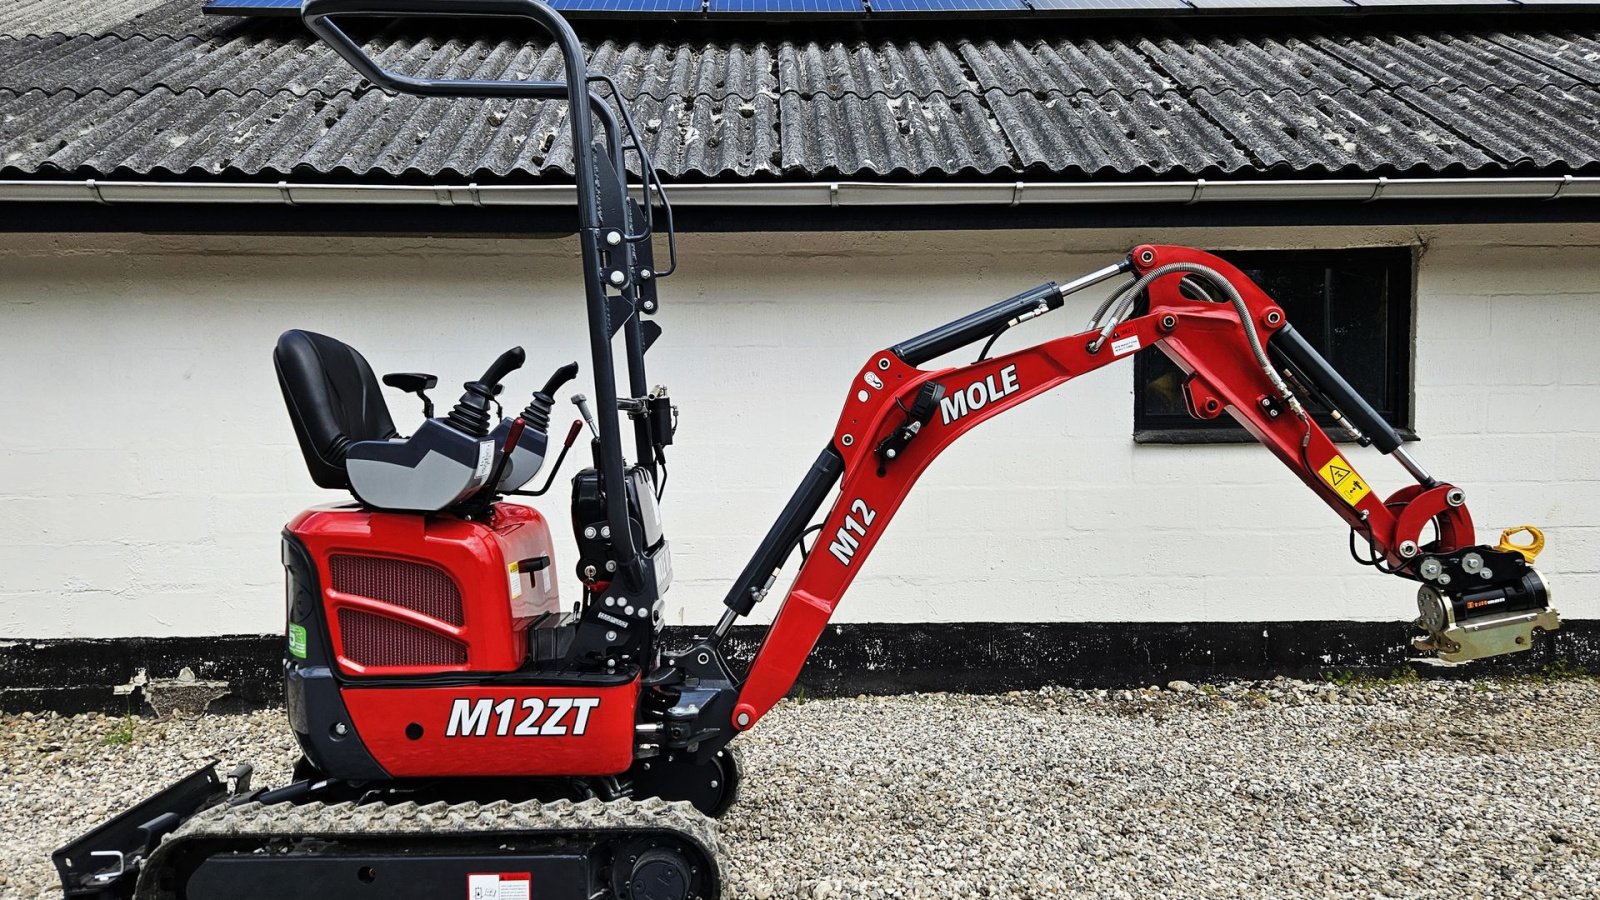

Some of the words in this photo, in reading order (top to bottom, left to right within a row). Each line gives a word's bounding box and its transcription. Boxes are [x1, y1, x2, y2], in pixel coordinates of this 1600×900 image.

[939, 364, 1020, 425] MOLE
[829, 498, 876, 566] M12
[445, 698, 600, 736] M12ZT
